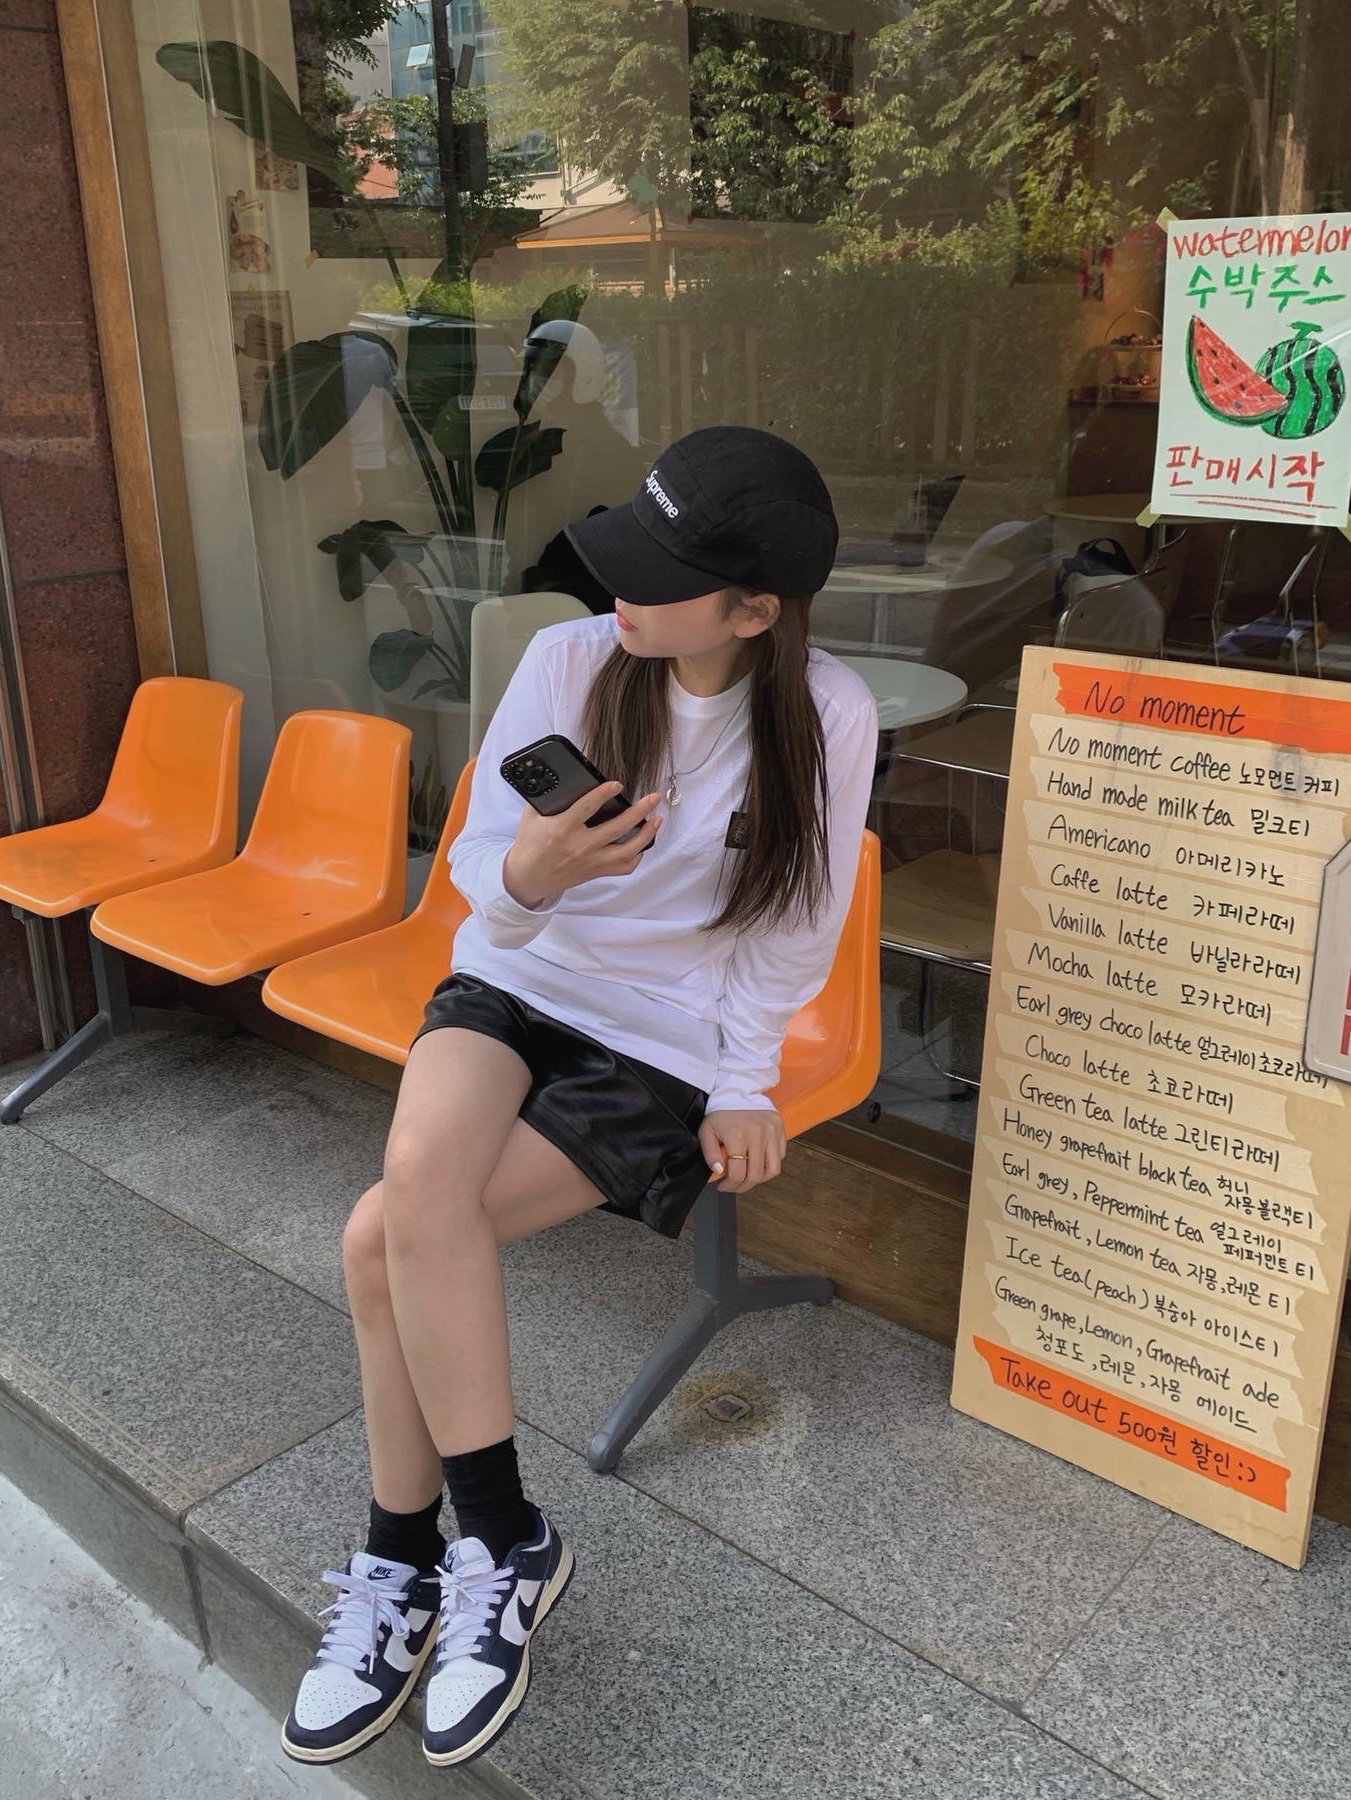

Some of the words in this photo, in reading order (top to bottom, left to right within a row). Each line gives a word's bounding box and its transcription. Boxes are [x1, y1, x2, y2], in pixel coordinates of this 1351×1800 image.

[1186, 264, 1346, 312] 수박주스
[646, 470, 678, 518] Supreme
[1166, 446, 1324, 502] 판매시작
[1084, 681, 1124, 713] No
[1140, 695, 1245, 734] moment
[1048, 728, 1079, 754] No
[1088, 739, 1162, 769] moment
[1171, 752, 1230, 780] coffee
[1304, 777, 1339, 795] 커피
[1048, 771, 1091, 800] Hand
[1103, 786, 1147, 810] made
[1158, 797, 1197, 820] milk
[1203, 800, 1234, 826] tea
[1252, 808, 1309, 836] 밀크티
[1048, 815, 1150, 858] Americano
[1176, 848, 1284, 886] 아메리카노
[1051, 864, 1100, 893] Caffe
[1117, 877, 1168, 910] latte
[1194, 895, 1293, 934] 카페라떼
[1049, 904, 1106, 938] Vanilla
[1119, 920, 1167, 954] latte
[1191, 942, 1300, 984] 바닐라라떼
[1028, 943, 1094, 978] Mocha
[1107, 961, 1158, 996] latte
[1181, 984, 1271, 1026] 모카라떼
[1017, 986, 1050, 1015] Earl
[1055, 1006, 1091, 1031] grey
[1100, 1009, 1142, 1039] choco
[1150, 1022, 1192, 1052] latte
[1026, 1035, 1071, 1067] Choco
[1084, 1050, 1130, 1084] latte
[1020, 1074, 1075, 1114] Green
[1082, 1094, 1113, 1122] tea
[1124, 1107, 1167, 1140] latte
[1003, 1109, 1052, 1145] Honey
[1140, 1153, 1176, 1185] black
[1180, 1168, 1211, 1196] tea
[1218, 1175, 1249, 1193] 허니
[1003, 1153, 1029, 1181] Earl
[1084, 1181, 1168, 1230] Peppermint
[1175, 1215, 1205, 1243] tea
[1006, 1237, 1042, 1268] Ice
[1155, 1295, 1196, 1327] 복숭아
[1096, 1230, 1143, 1259] Lemon
[1150, 1249, 1181, 1276] tea
[995, 1277, 1036, 1313] Green
[1243, 1382, 1279, 1409] ade
[1001, 1357, 1052, 1400] Take
[1063, 1390, 1108, 1424] out
[1118, 1412, 1177, 1456] 500원
[1197, 1395, 1257, 1433] 에이드
[373, 1565, 392, 1576] NIKE
